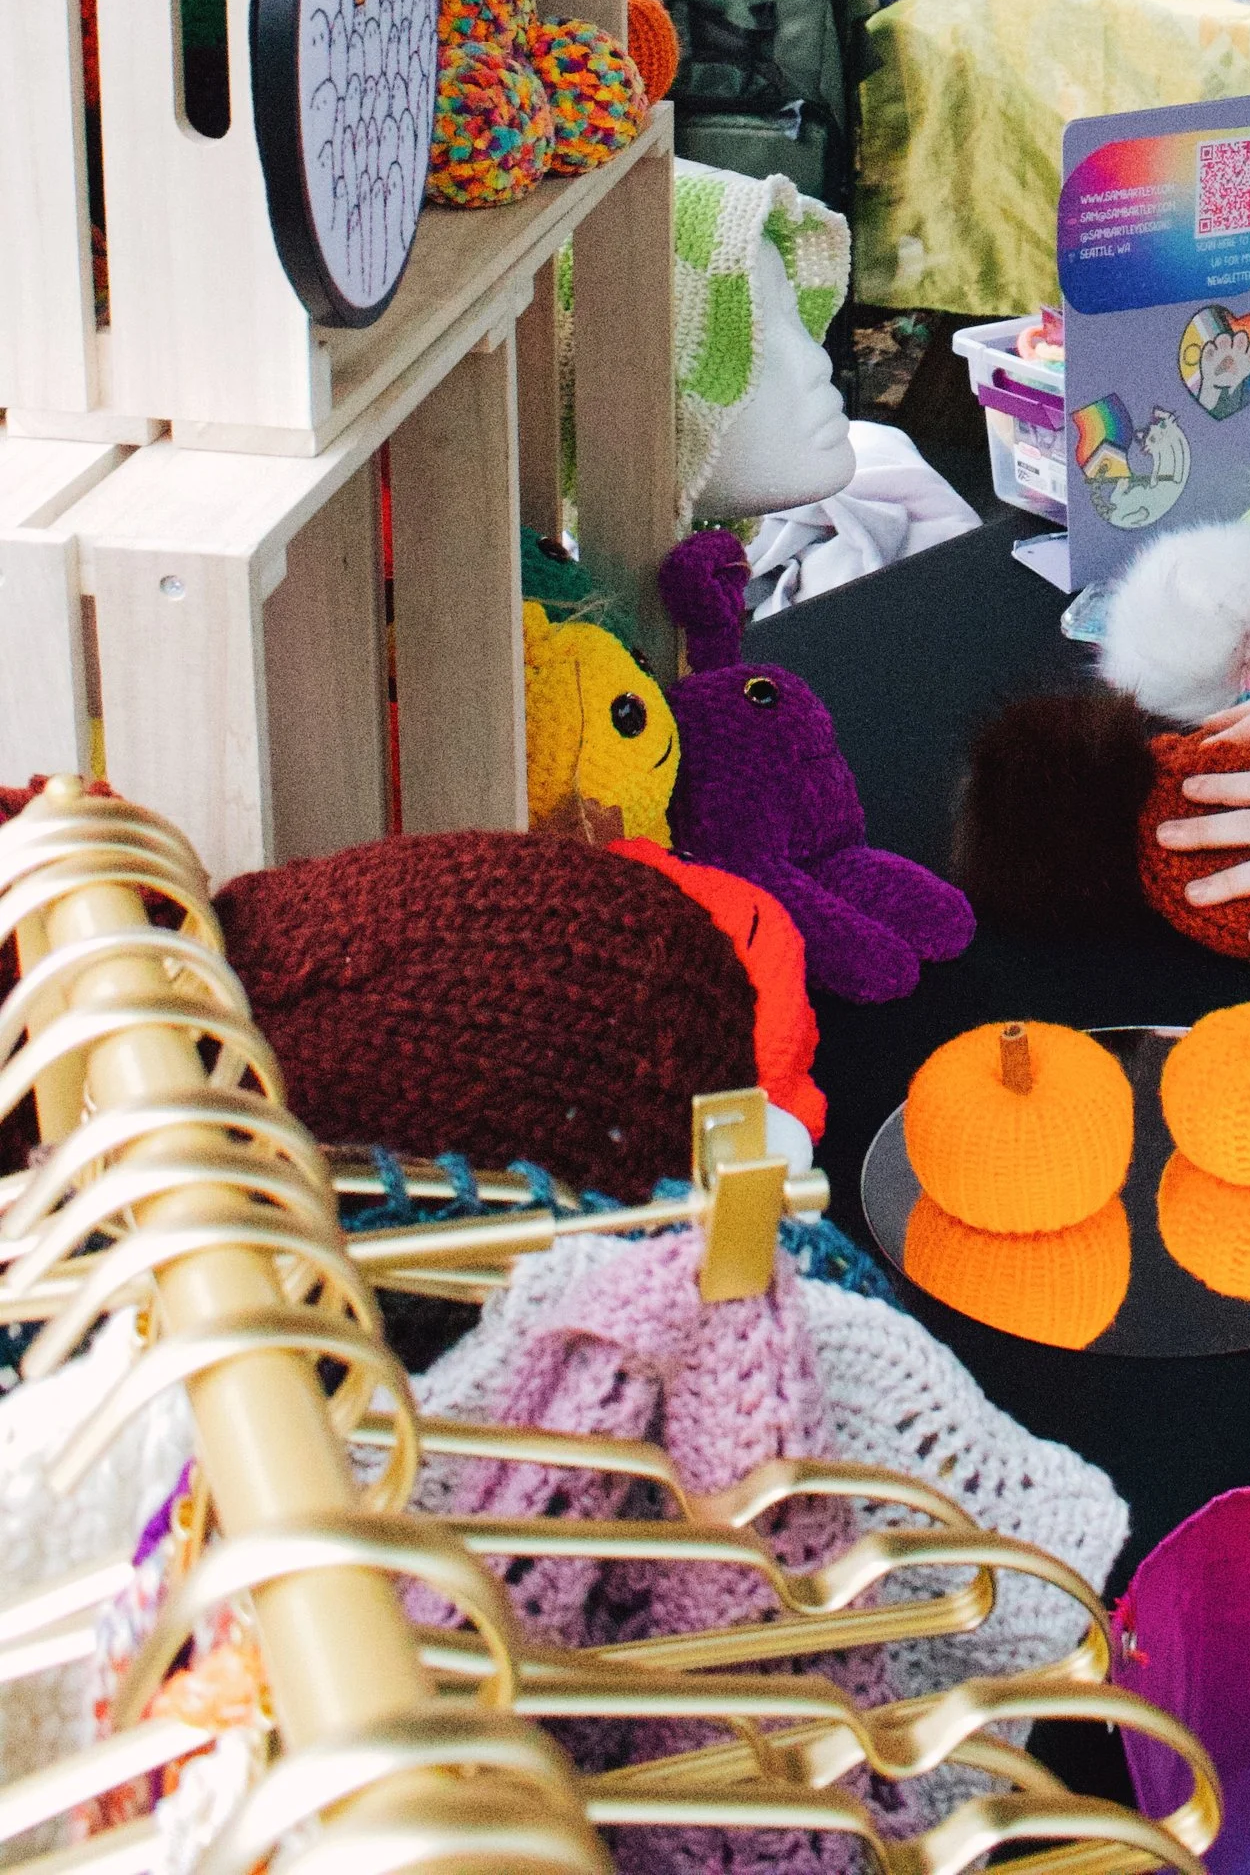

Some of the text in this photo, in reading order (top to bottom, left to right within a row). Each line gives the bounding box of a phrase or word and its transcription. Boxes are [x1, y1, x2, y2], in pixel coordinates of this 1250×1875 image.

[1080, 182, 1175, 204] WWW.SAMBARTLEY.COM
[1080, 201, 1176, 223] SAM@SAMBARTLEY.COM
[1239, 234, 1249, 245] TO
[1080, 242, 1131, 260] SEATTLE, WA
[1224, 255, 1239, 266] FOR
